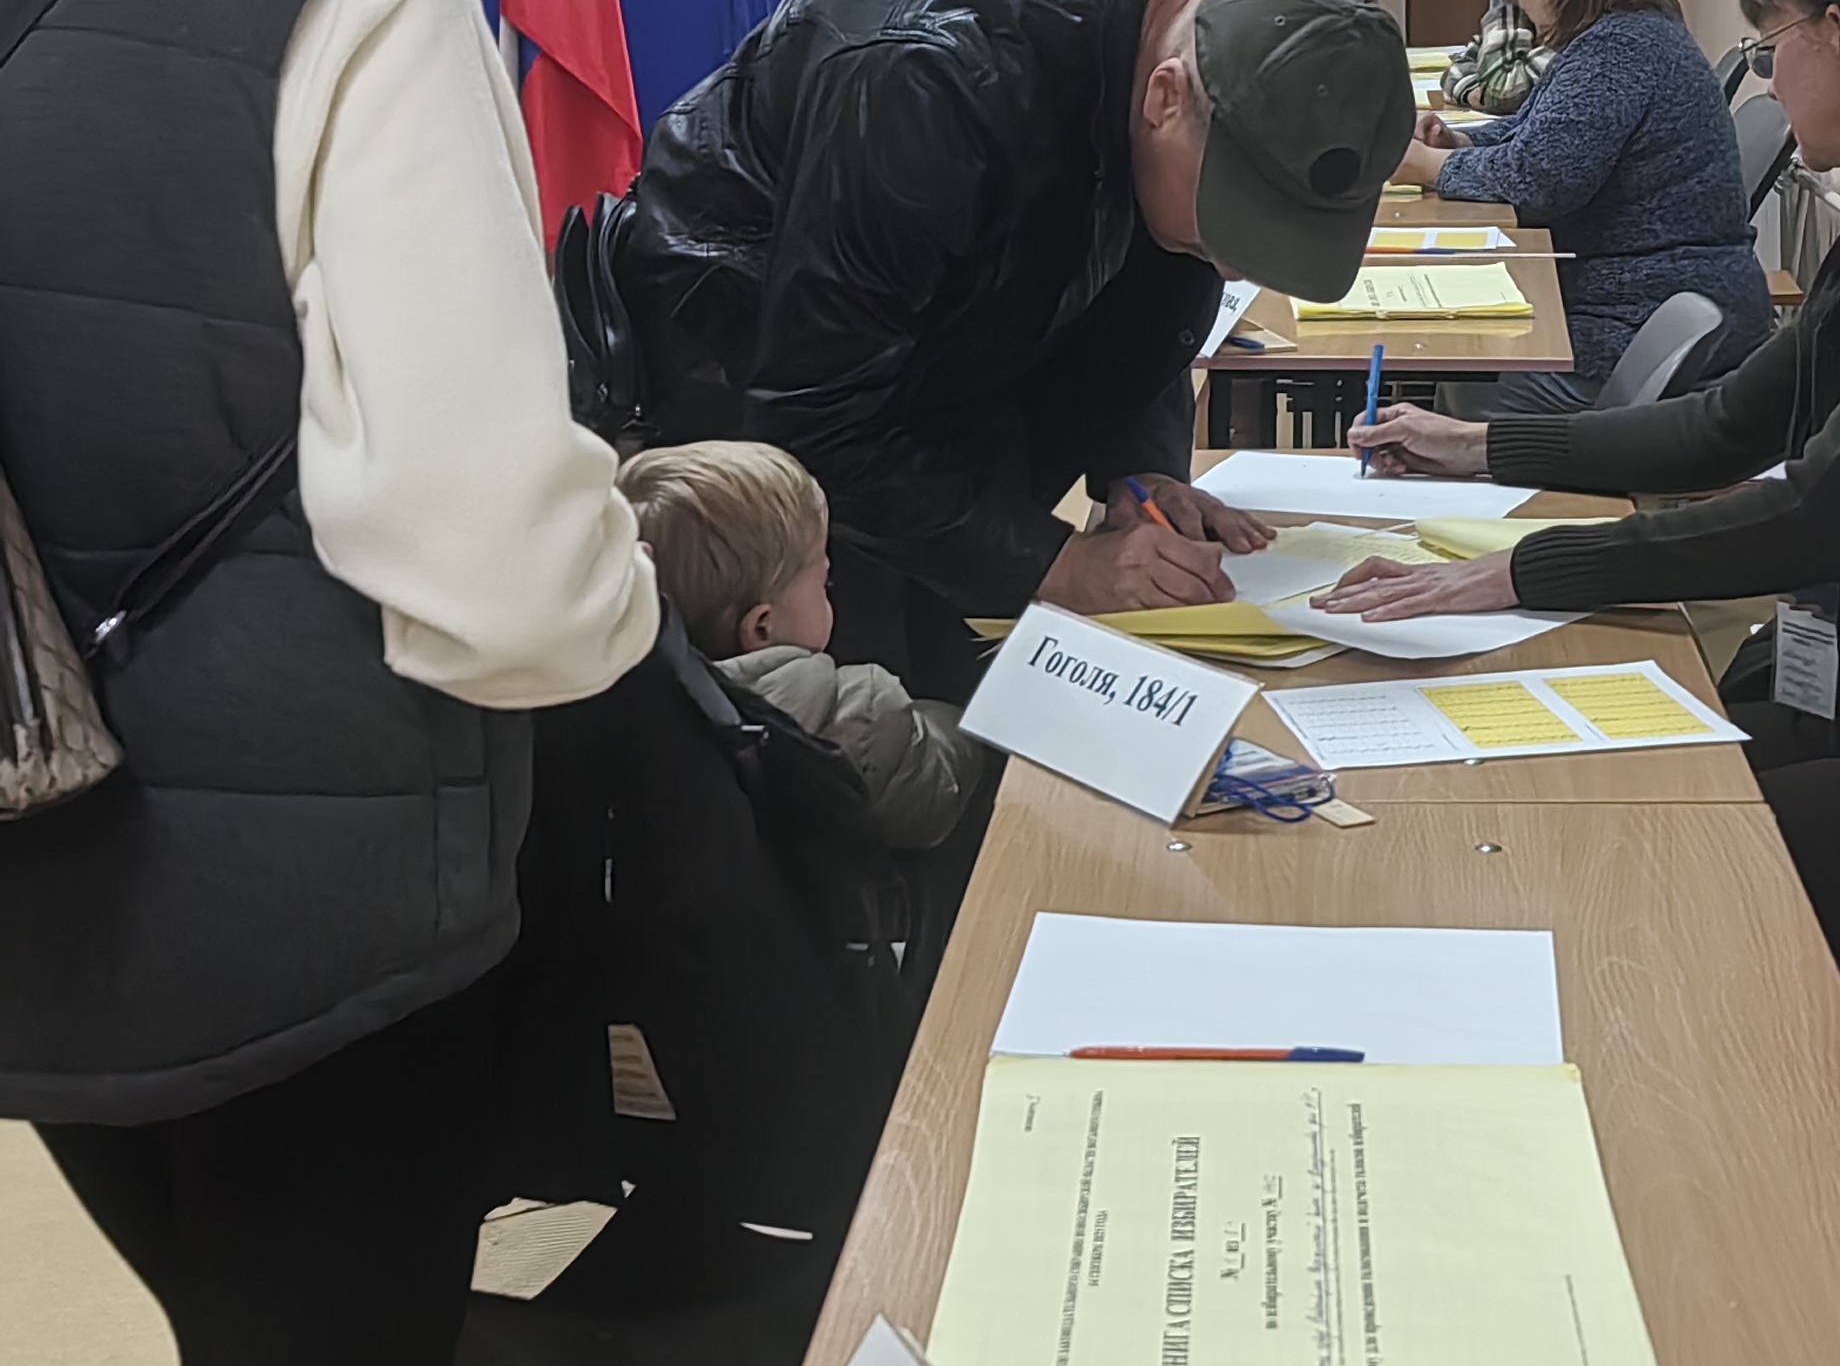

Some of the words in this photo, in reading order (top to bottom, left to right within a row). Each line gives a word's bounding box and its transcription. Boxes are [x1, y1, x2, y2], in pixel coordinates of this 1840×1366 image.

[1027, 635, 1118, 705] Гоголя,
[1123, 674, 1200, 727] 184/1
[1170, 1136, 1200, 1242] ИЗБИРАТЕЛЕЙ
[1165, 1249, 1195, 1317] СПИСКА
